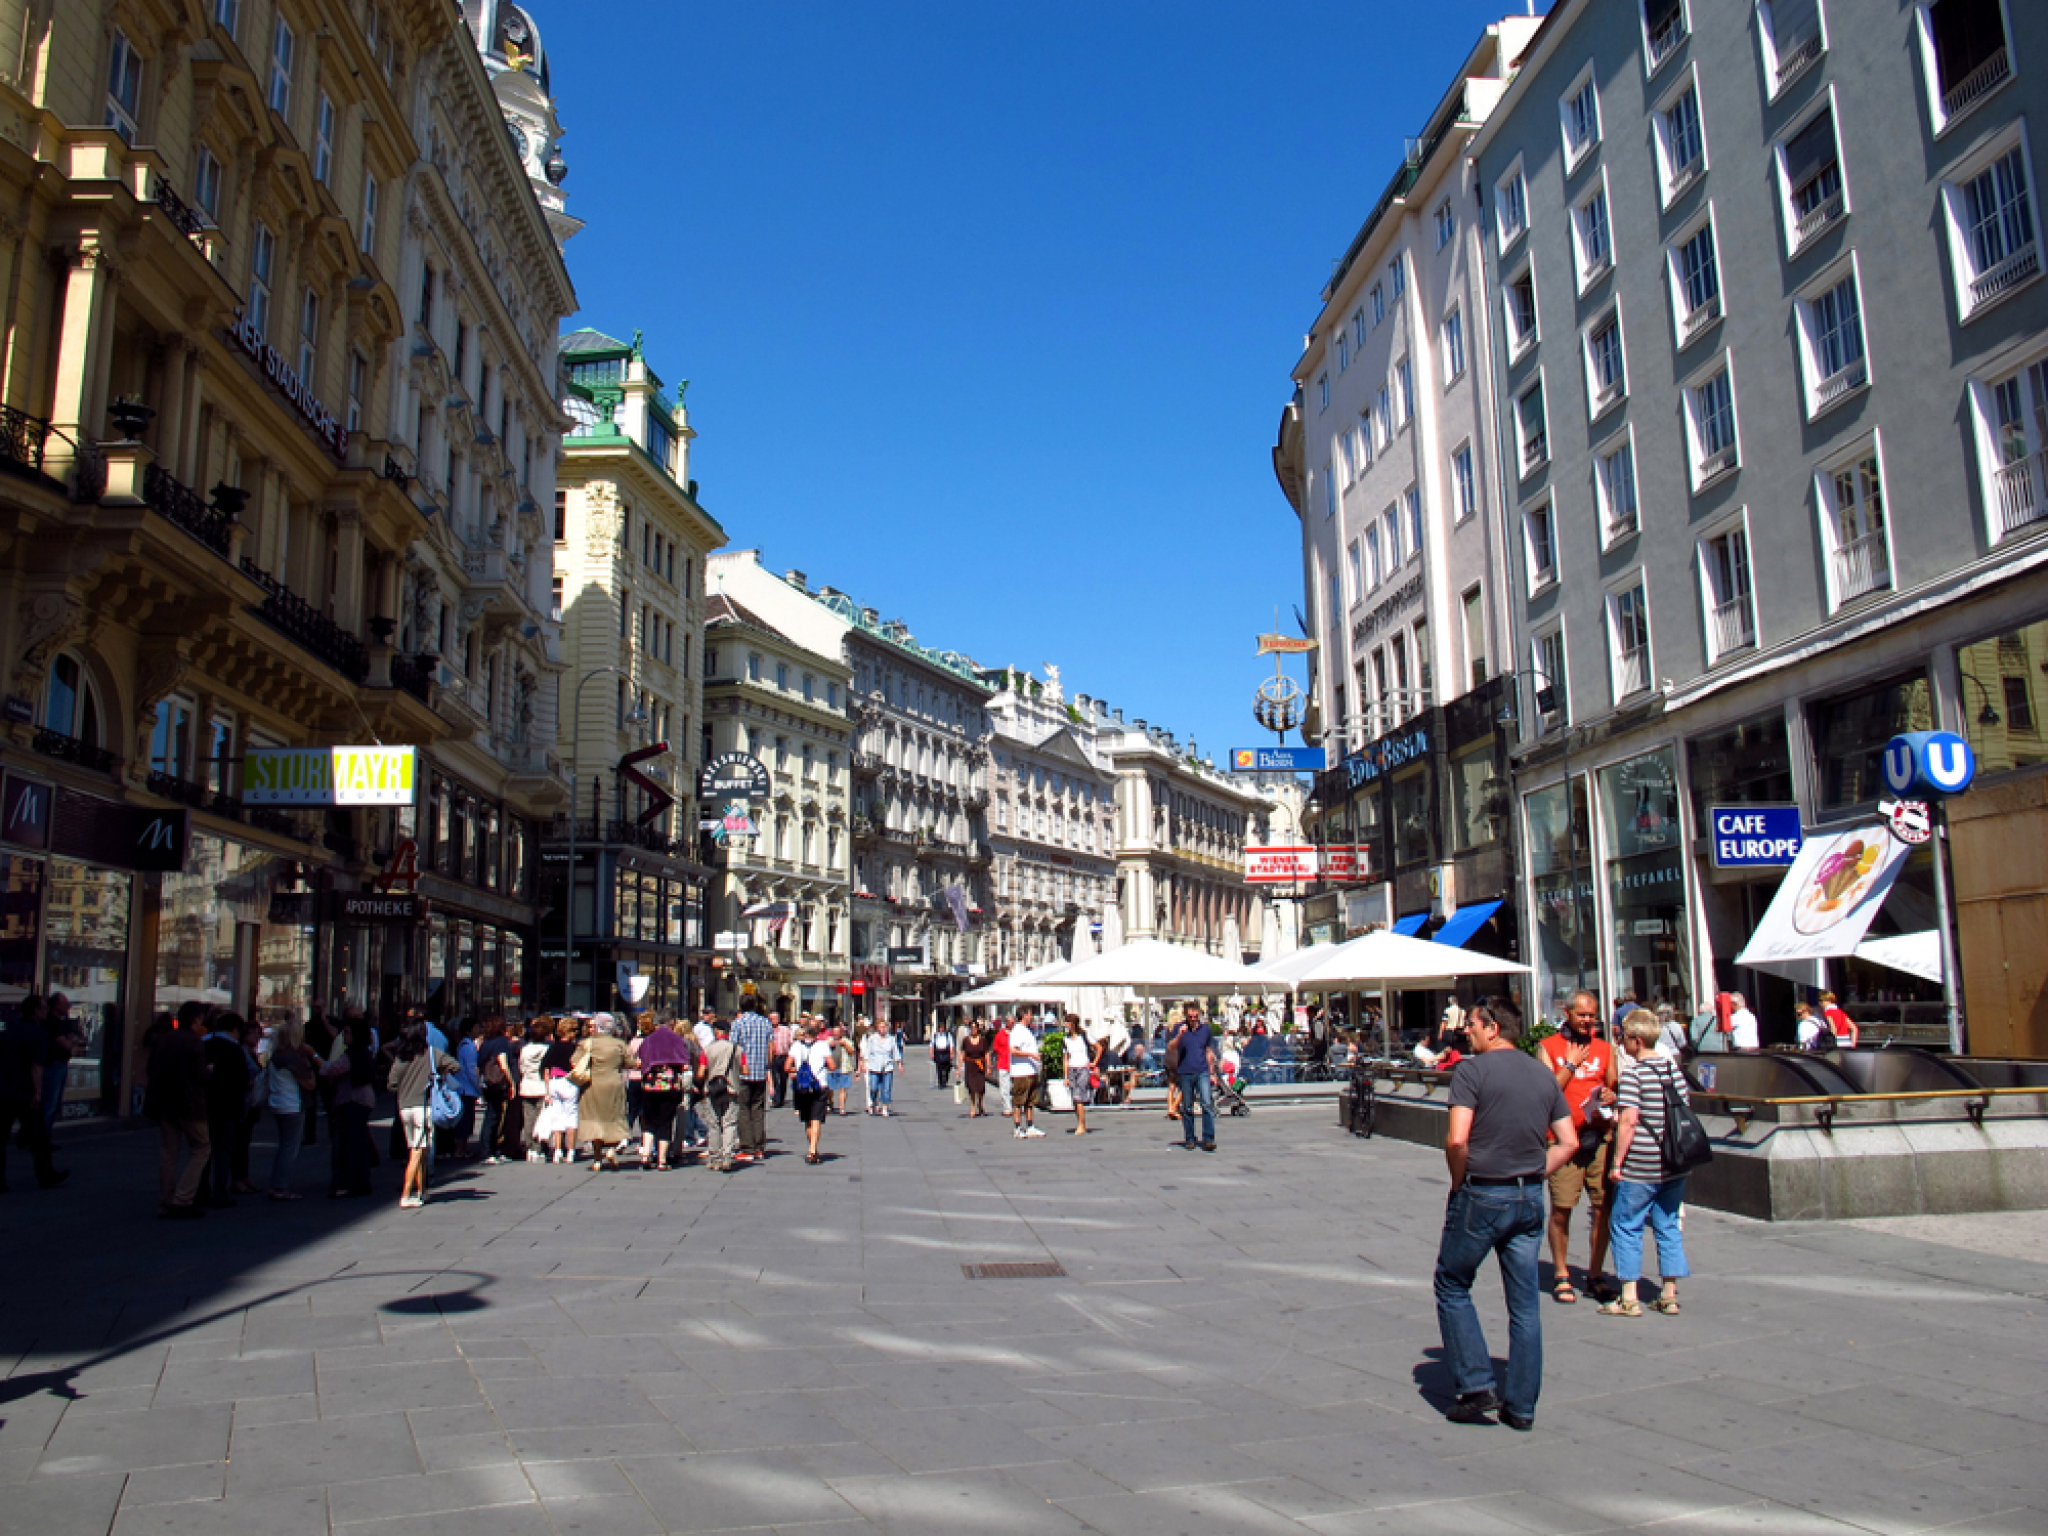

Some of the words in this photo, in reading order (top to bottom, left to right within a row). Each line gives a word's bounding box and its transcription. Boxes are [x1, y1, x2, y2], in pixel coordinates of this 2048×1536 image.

[254, 754, 403, 790] STURMAYR
[1886, 745, 1912, 790] U
[1928, 742, 1966, 787] U
[714, 780, 753, 789] BUFFET
[1718, 815, 1767, 834] CAFE
[1720, 839, 1799, 858] EUROPE
[344, 898, 413, 917] APOTHEKE
